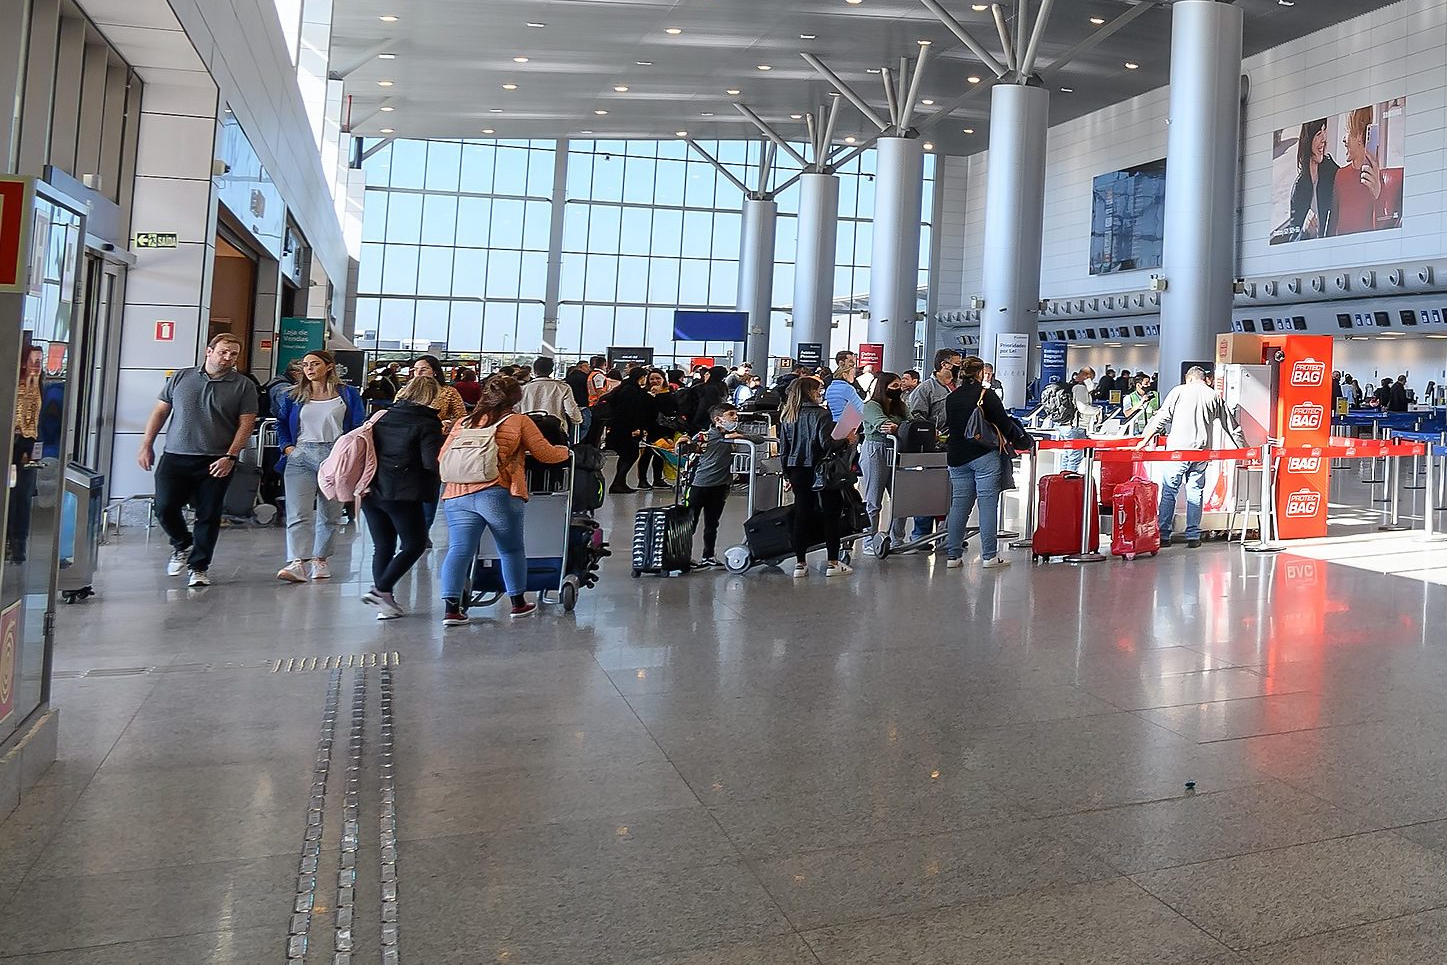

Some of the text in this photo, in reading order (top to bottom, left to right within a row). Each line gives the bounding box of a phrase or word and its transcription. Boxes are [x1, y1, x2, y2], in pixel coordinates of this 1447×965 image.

[1293, 372, 1320, 382] BAG
[1291, 415, 1319, 426] BAG
[1290, 458, 1317, 469] BAG
[1288, 502, 1316, 514] BAG
